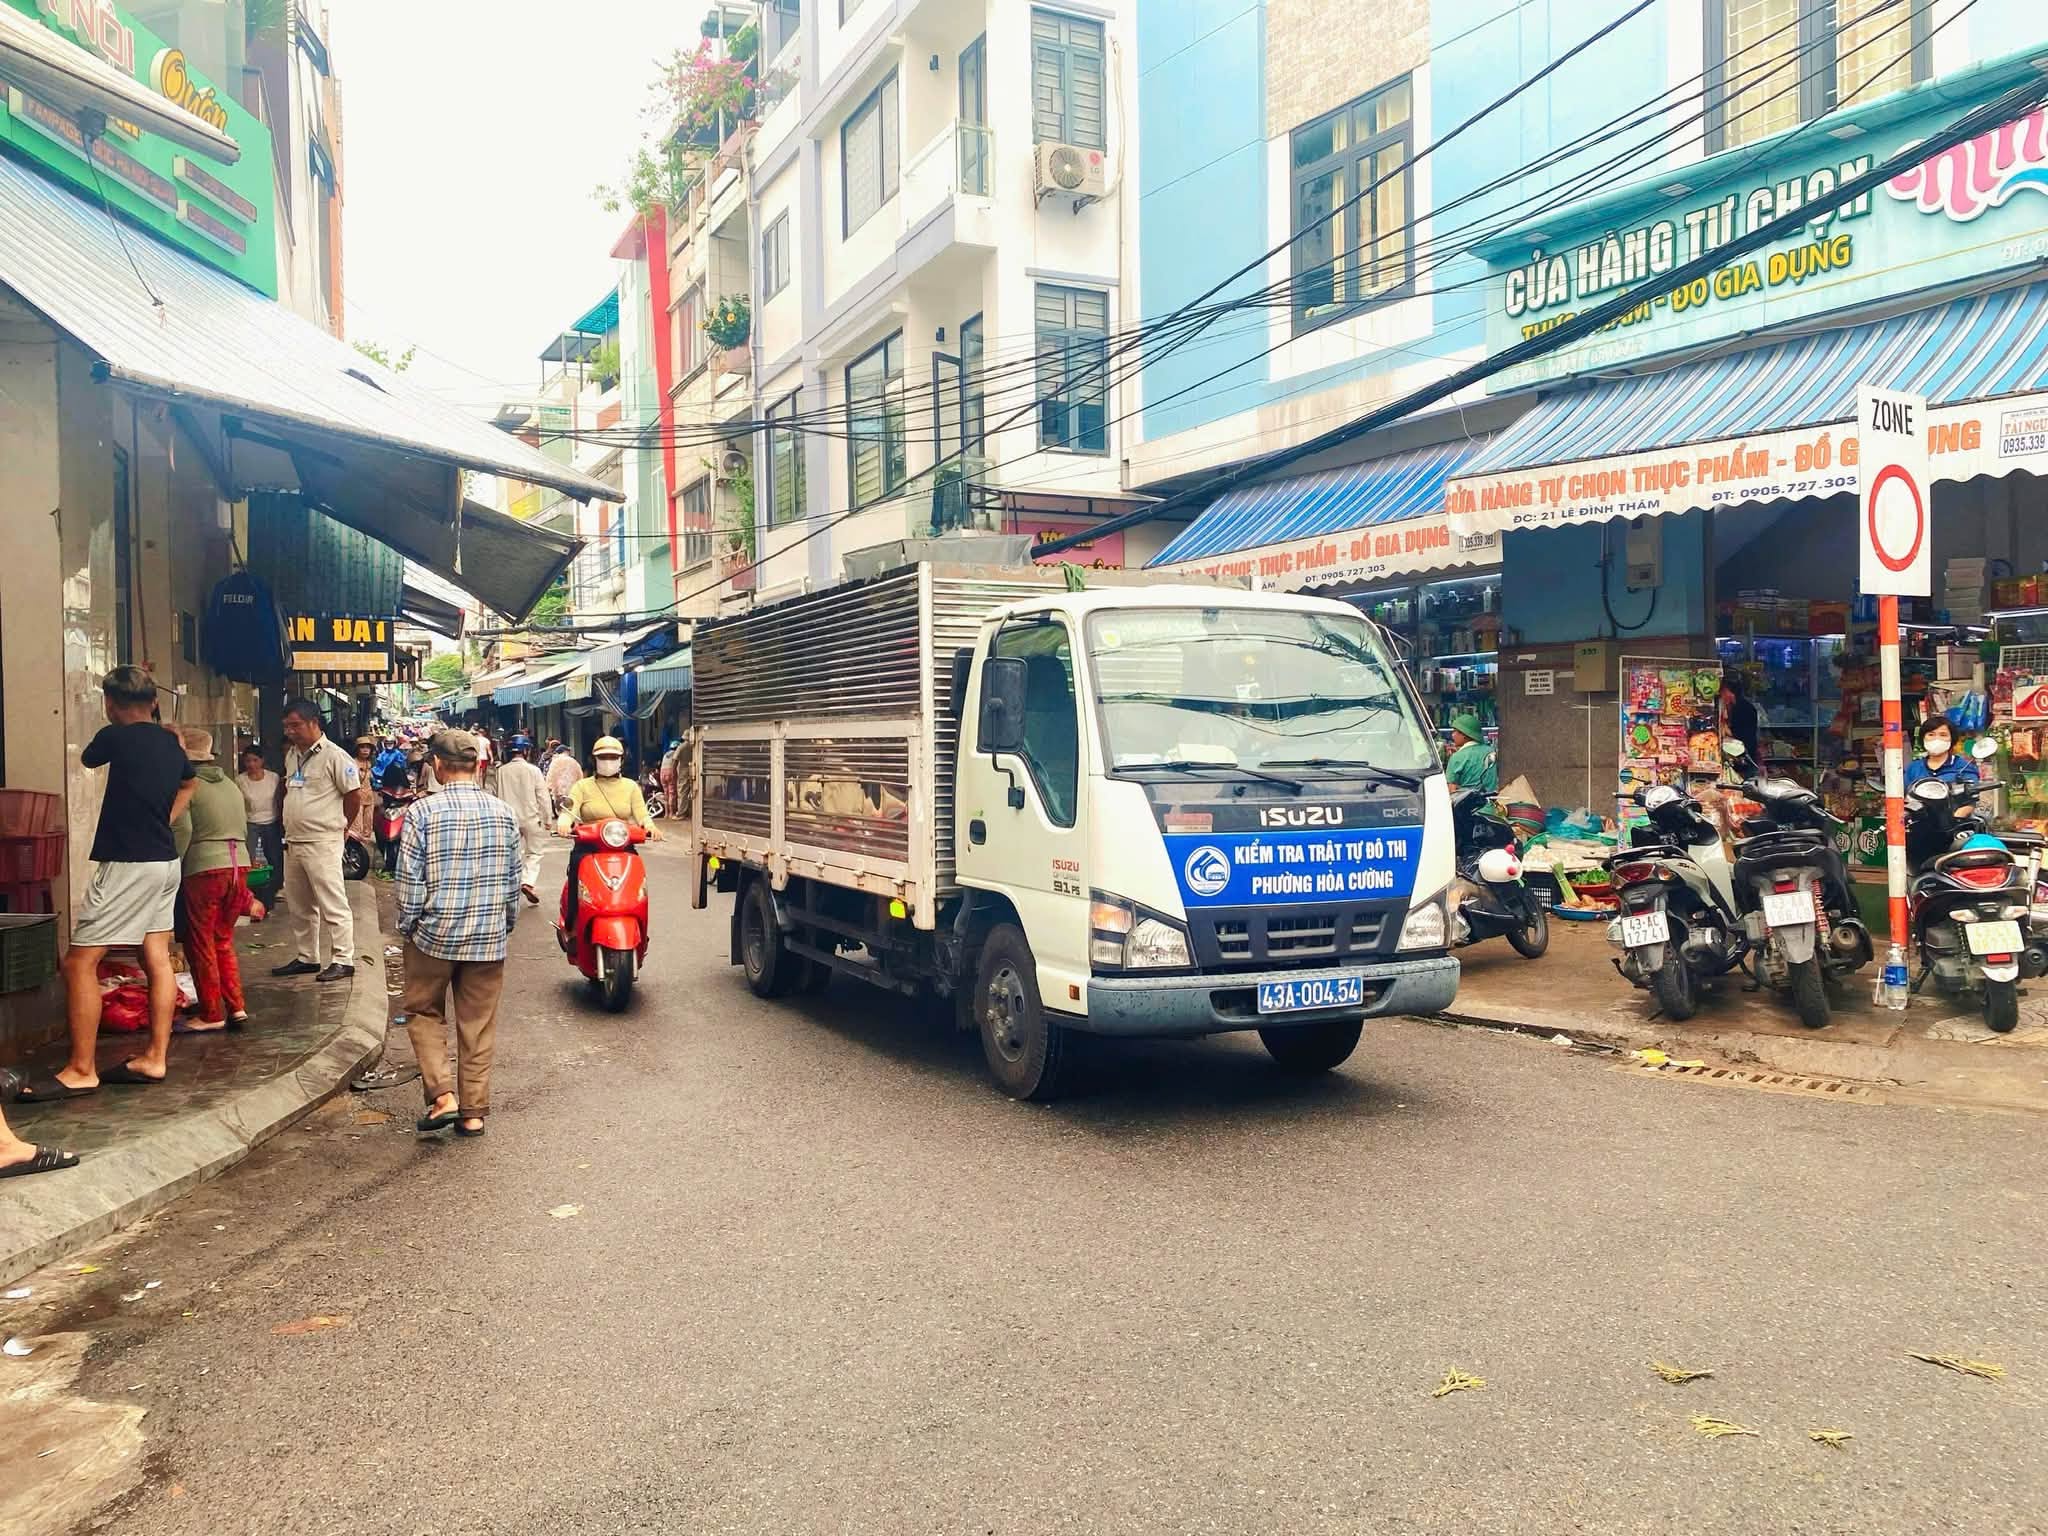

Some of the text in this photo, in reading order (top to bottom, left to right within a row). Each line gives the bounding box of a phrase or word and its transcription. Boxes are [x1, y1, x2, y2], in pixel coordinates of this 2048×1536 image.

[1505, 248, 1571, 318] CỬA
[1577, 220, 1676, 298] HÀNG
[1746, 154, 1873, 239] CHỌN
[1714, 261, 1763, 300] GIA
[1769, 234, 1852, 287] DỤNG
[1872, 398, 1914, 436] ZONE
[1481, 480, 1533, 510] HÀNG
[1538, 476, 1565, 507] TỰ
[1568, 470, 1627, 502] CHỌN
[1633, 459, 1690, 495] THỰC
[1697, 442, 1769, 484] PHẨM
[1740, 476, 1858, 498] 0905.727.303
[1541, 511, 1556, 521] 21
[1561, 509, 1575, 519] LÊ
[1580, 504, 1614, 516] ĐÌNH
[1375, 533, 1401, 558] GIA
[1405, 524, 1450, 556] DỤNG
[1321, 563, 1386, 581] 0905.727.303
[1260, 806, 1344, 827] ISUZU
[1382, 807, 1419, 818] QKR
[1234, 837, 1408, 866] KIỂM TRA TRẬT TỰ ĐÔ THỊ
[1052, 859, 1080, 873] ISUZU
[1054, 880, 1070, 894] 91
[1252, 867, 1394, 895] PHƯỜNG HÒA CƯỜNG
[1262, 978, 1359, 1009] 43A-004.54
